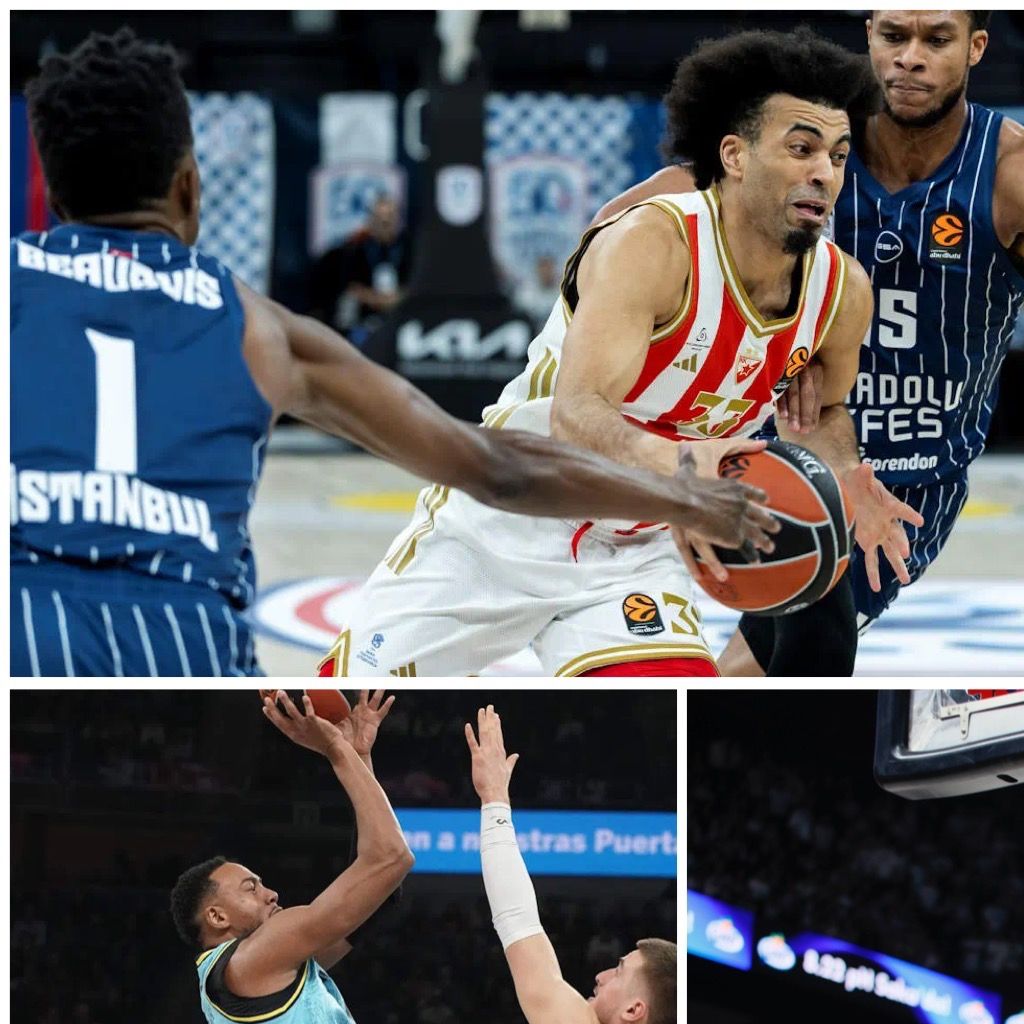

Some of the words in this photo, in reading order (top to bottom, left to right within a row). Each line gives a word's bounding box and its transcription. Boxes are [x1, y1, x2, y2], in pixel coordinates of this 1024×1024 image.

[862, 288, 918, 349] 5
[85, 327, 137, 473] 1
[845, 372, 963, 412] ADOLU
[848, 407, 943, 444] FES
[662, 591, 700, 637] 3
